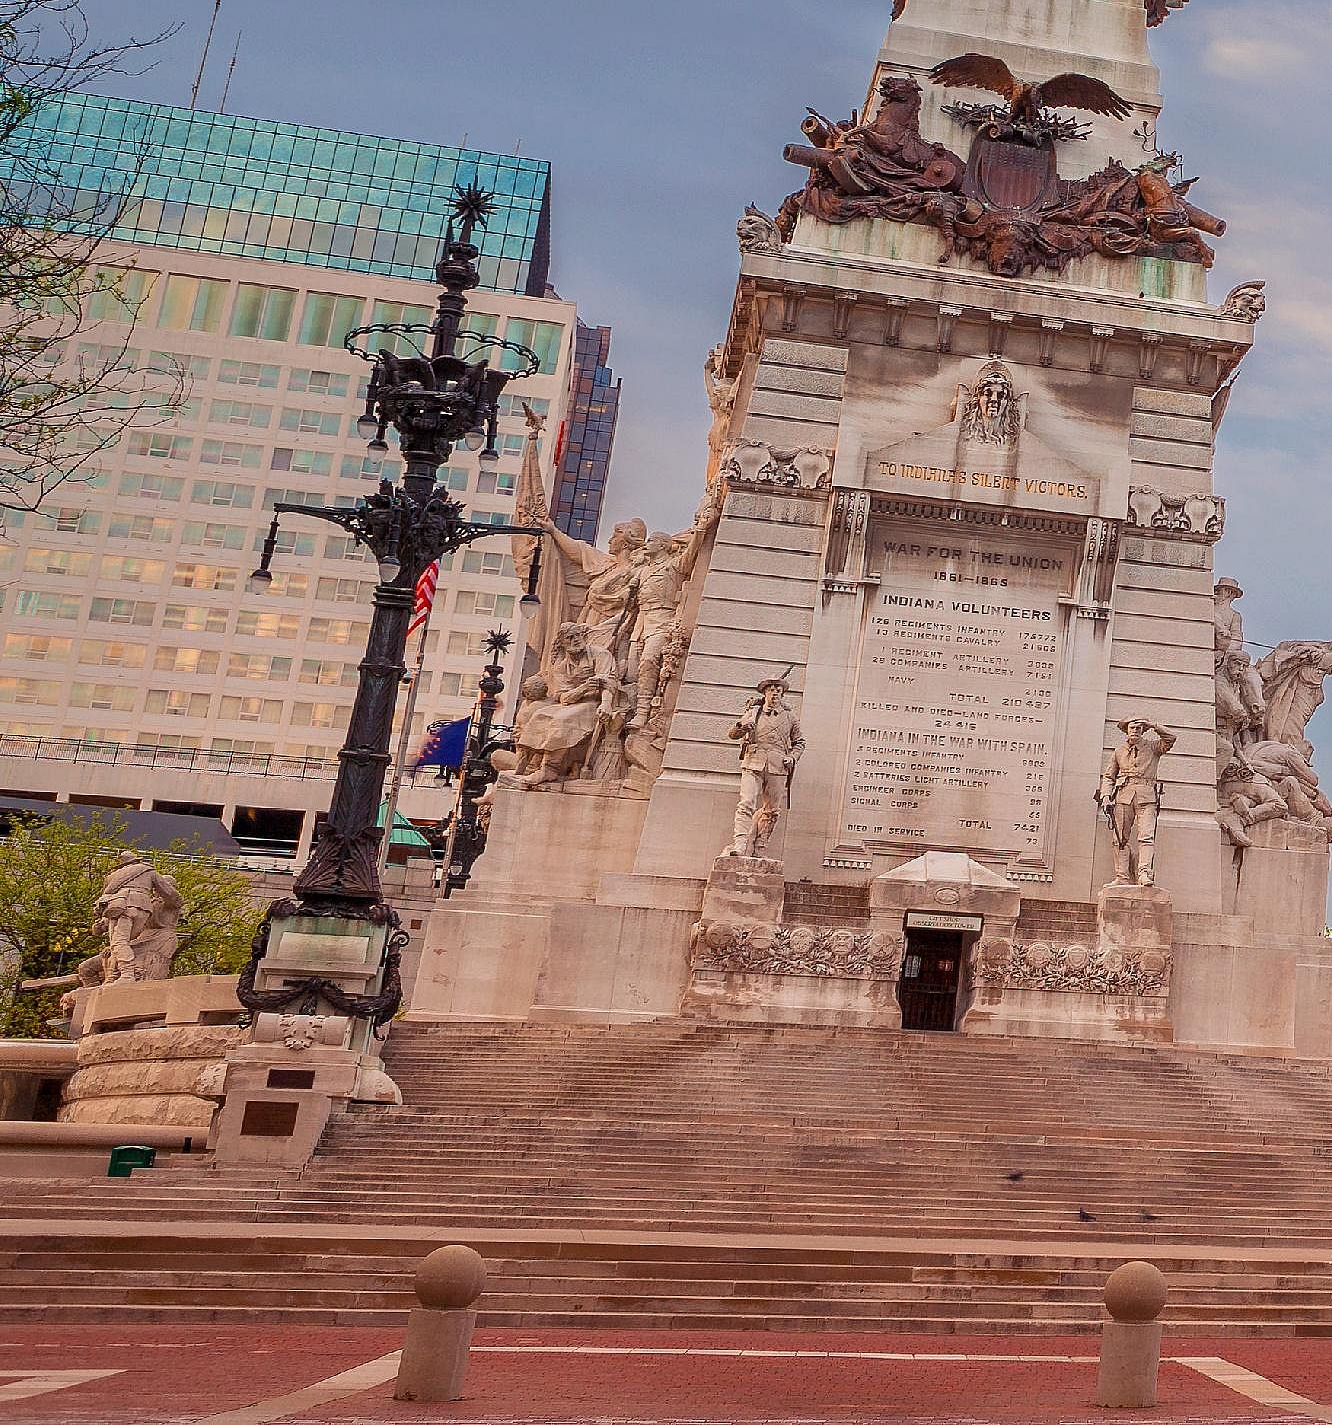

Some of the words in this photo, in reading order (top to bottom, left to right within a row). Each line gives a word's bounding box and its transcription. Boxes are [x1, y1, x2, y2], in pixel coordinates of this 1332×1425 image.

[878, 461, 898, 476] TO
[971, 471, 1021, 490] SILENT
[883, 540, 921, 558] WAR
[926, 545, 963, 561] FOR
[969, 550, 1004, 566] THE
[1008, 554, 1064, 571] UNION
[882, 594, 945, 611] INDIANA
[951, 600, 1052, 622] VOLUNTEERS
[894, 619, 953, 632] REGIMENTS
[957, 625, 1006, 637] INFANTRY
[893, 630, 951, 642] REGIMENTS
[956, 636, 1001, 647] CAVALRY
[891, 647, 944, 659] REGIMENT
[952, 654, 1010, 666] ARTILLERY
[890, 657, 949, 670] COMPANIES
[958, 664, 1015, 677] ARTILLERY
[888, 675, 915, 685] NAVY
[949, 692, 990, 704] TOTAL
[860, 702, 899, 711] KILLED
[904, 705, 925, 714] AND
[857, 727, 904, 743] INDIANA
[907, 731, 920, 744] IN
[922, 734, 946, 747] THE
[949, 736, 974, 749] WAR
[977, 737, 1008, 752] WITH
[866, 746, 919, 757] REGIMENTS
[922, 750, 965, 762] INFANTRY
[864, 759, 906, 770] COLORED
[910, 763, 961, 774] COMPANIES
[965, 767, 1009, 779] INFANTRY
[863, 771, 911, 782] BATTERIES
[914, 775, 942, 784] LIGHT
[942, 778, 989, 791] ARTILLERY
[853, 784, 895, 794] ENGINEER
[901, 788, 932, 797] CORPS
[850, 797, 880, 806] SIGNAL
[890, 800, 919, 809] CORPS
[847, 824, 868, 832] DIED
[888, 827, 926, 837] SERVICE
[959, 819, 992, 830] TOTAL
